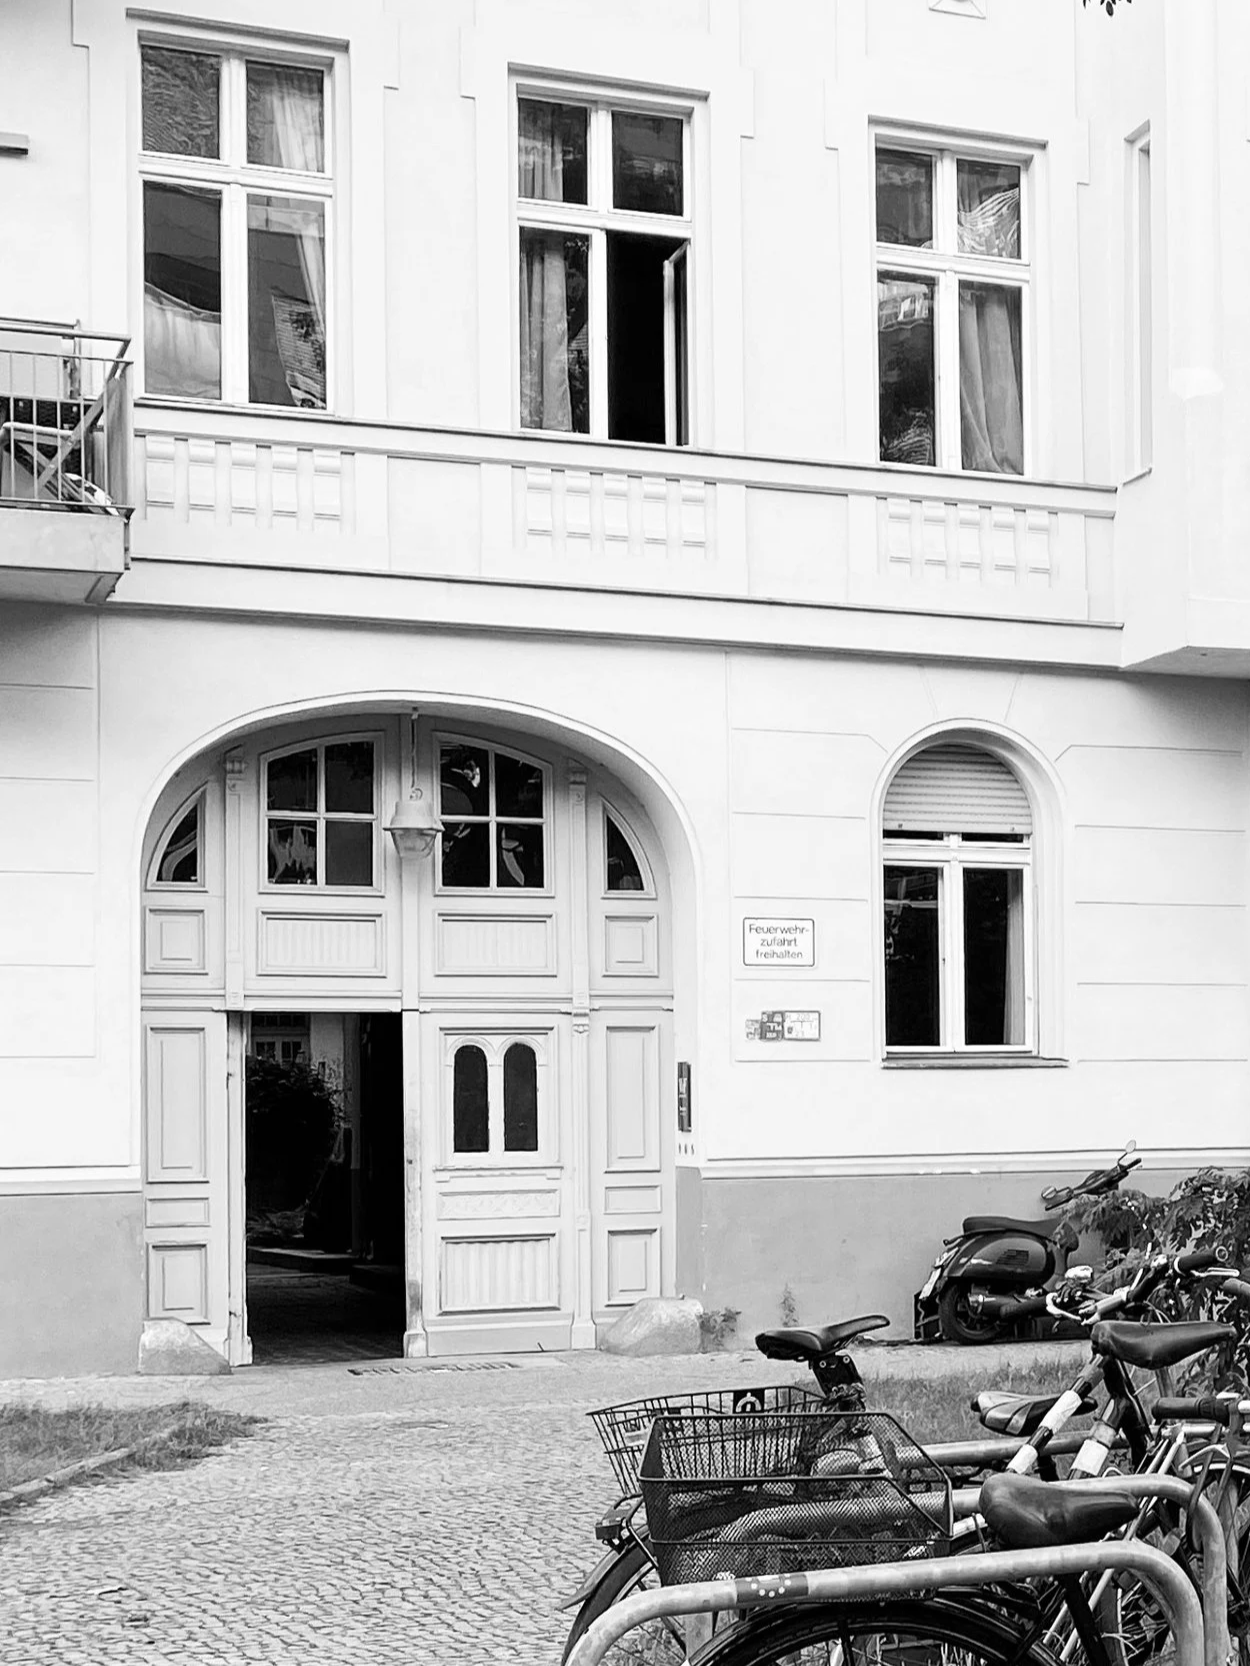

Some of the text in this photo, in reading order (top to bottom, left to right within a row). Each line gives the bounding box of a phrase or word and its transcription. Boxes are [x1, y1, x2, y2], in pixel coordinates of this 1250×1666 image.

[749, 923, 810, 934] Feuerwehr-
[760, 936, 798, 947] zufahrt
[756, 949, 803, 959] freihalten
